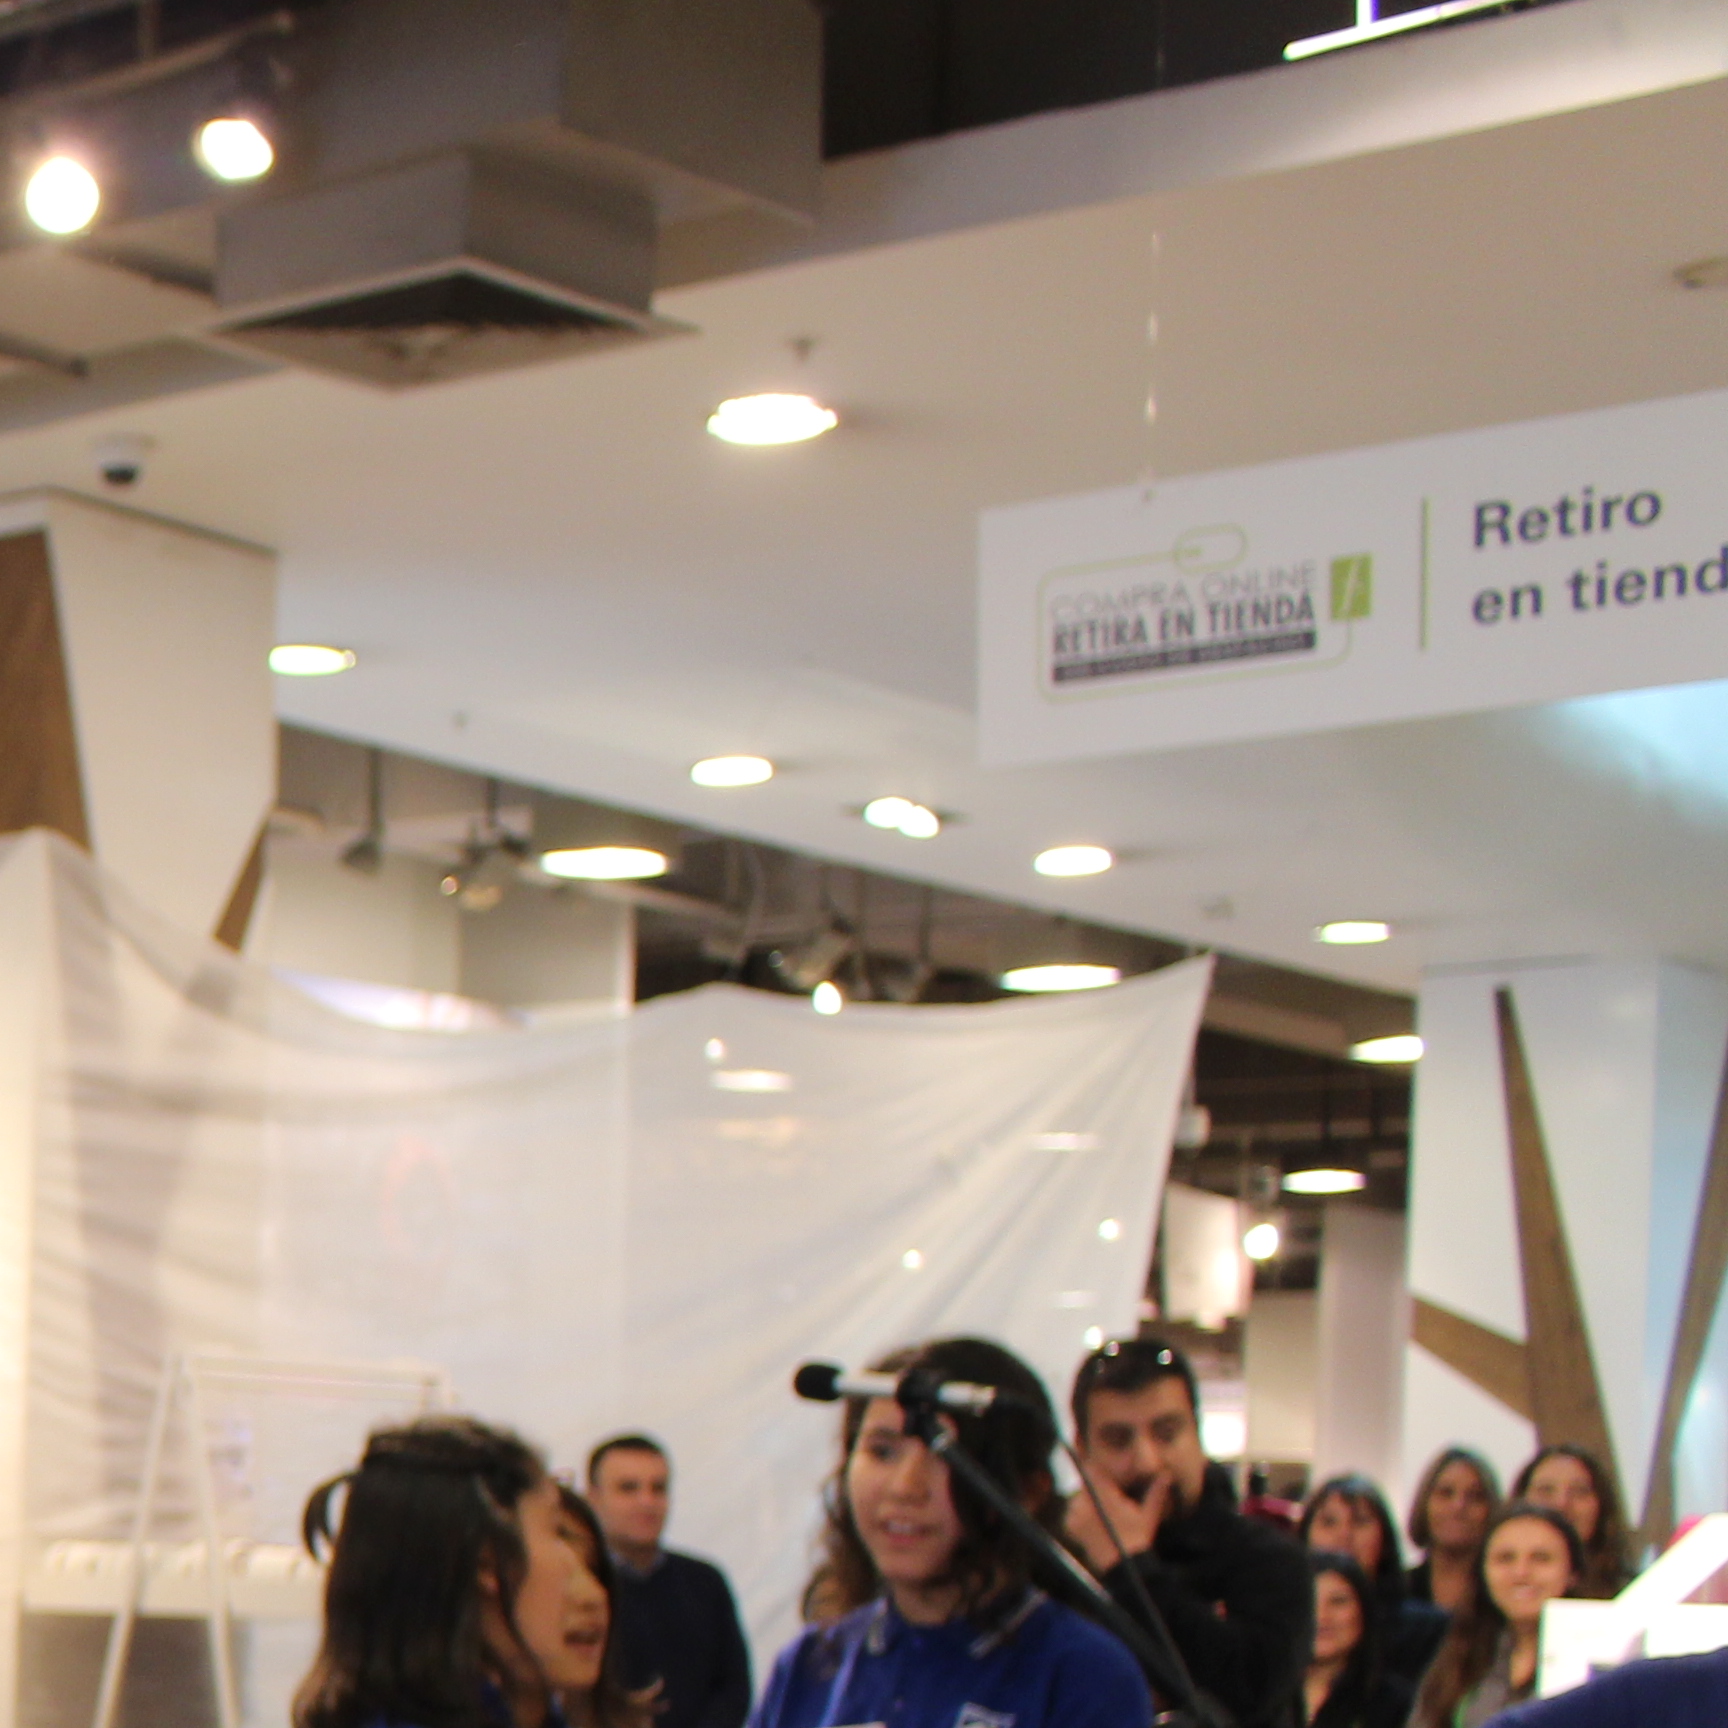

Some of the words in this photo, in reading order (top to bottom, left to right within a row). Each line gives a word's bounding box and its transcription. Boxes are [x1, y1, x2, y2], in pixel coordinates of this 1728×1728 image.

[1474, 485, 1662, 548] Retiro
[1201, 560, 1316, 600] ONLINE
[1472, 584, 1543, 625] en
[1053, 614, 1148, 654] RETIRA
[1159, 607, 1196, 642] EN
[1207, 588, 1315, 634] TIENDA
